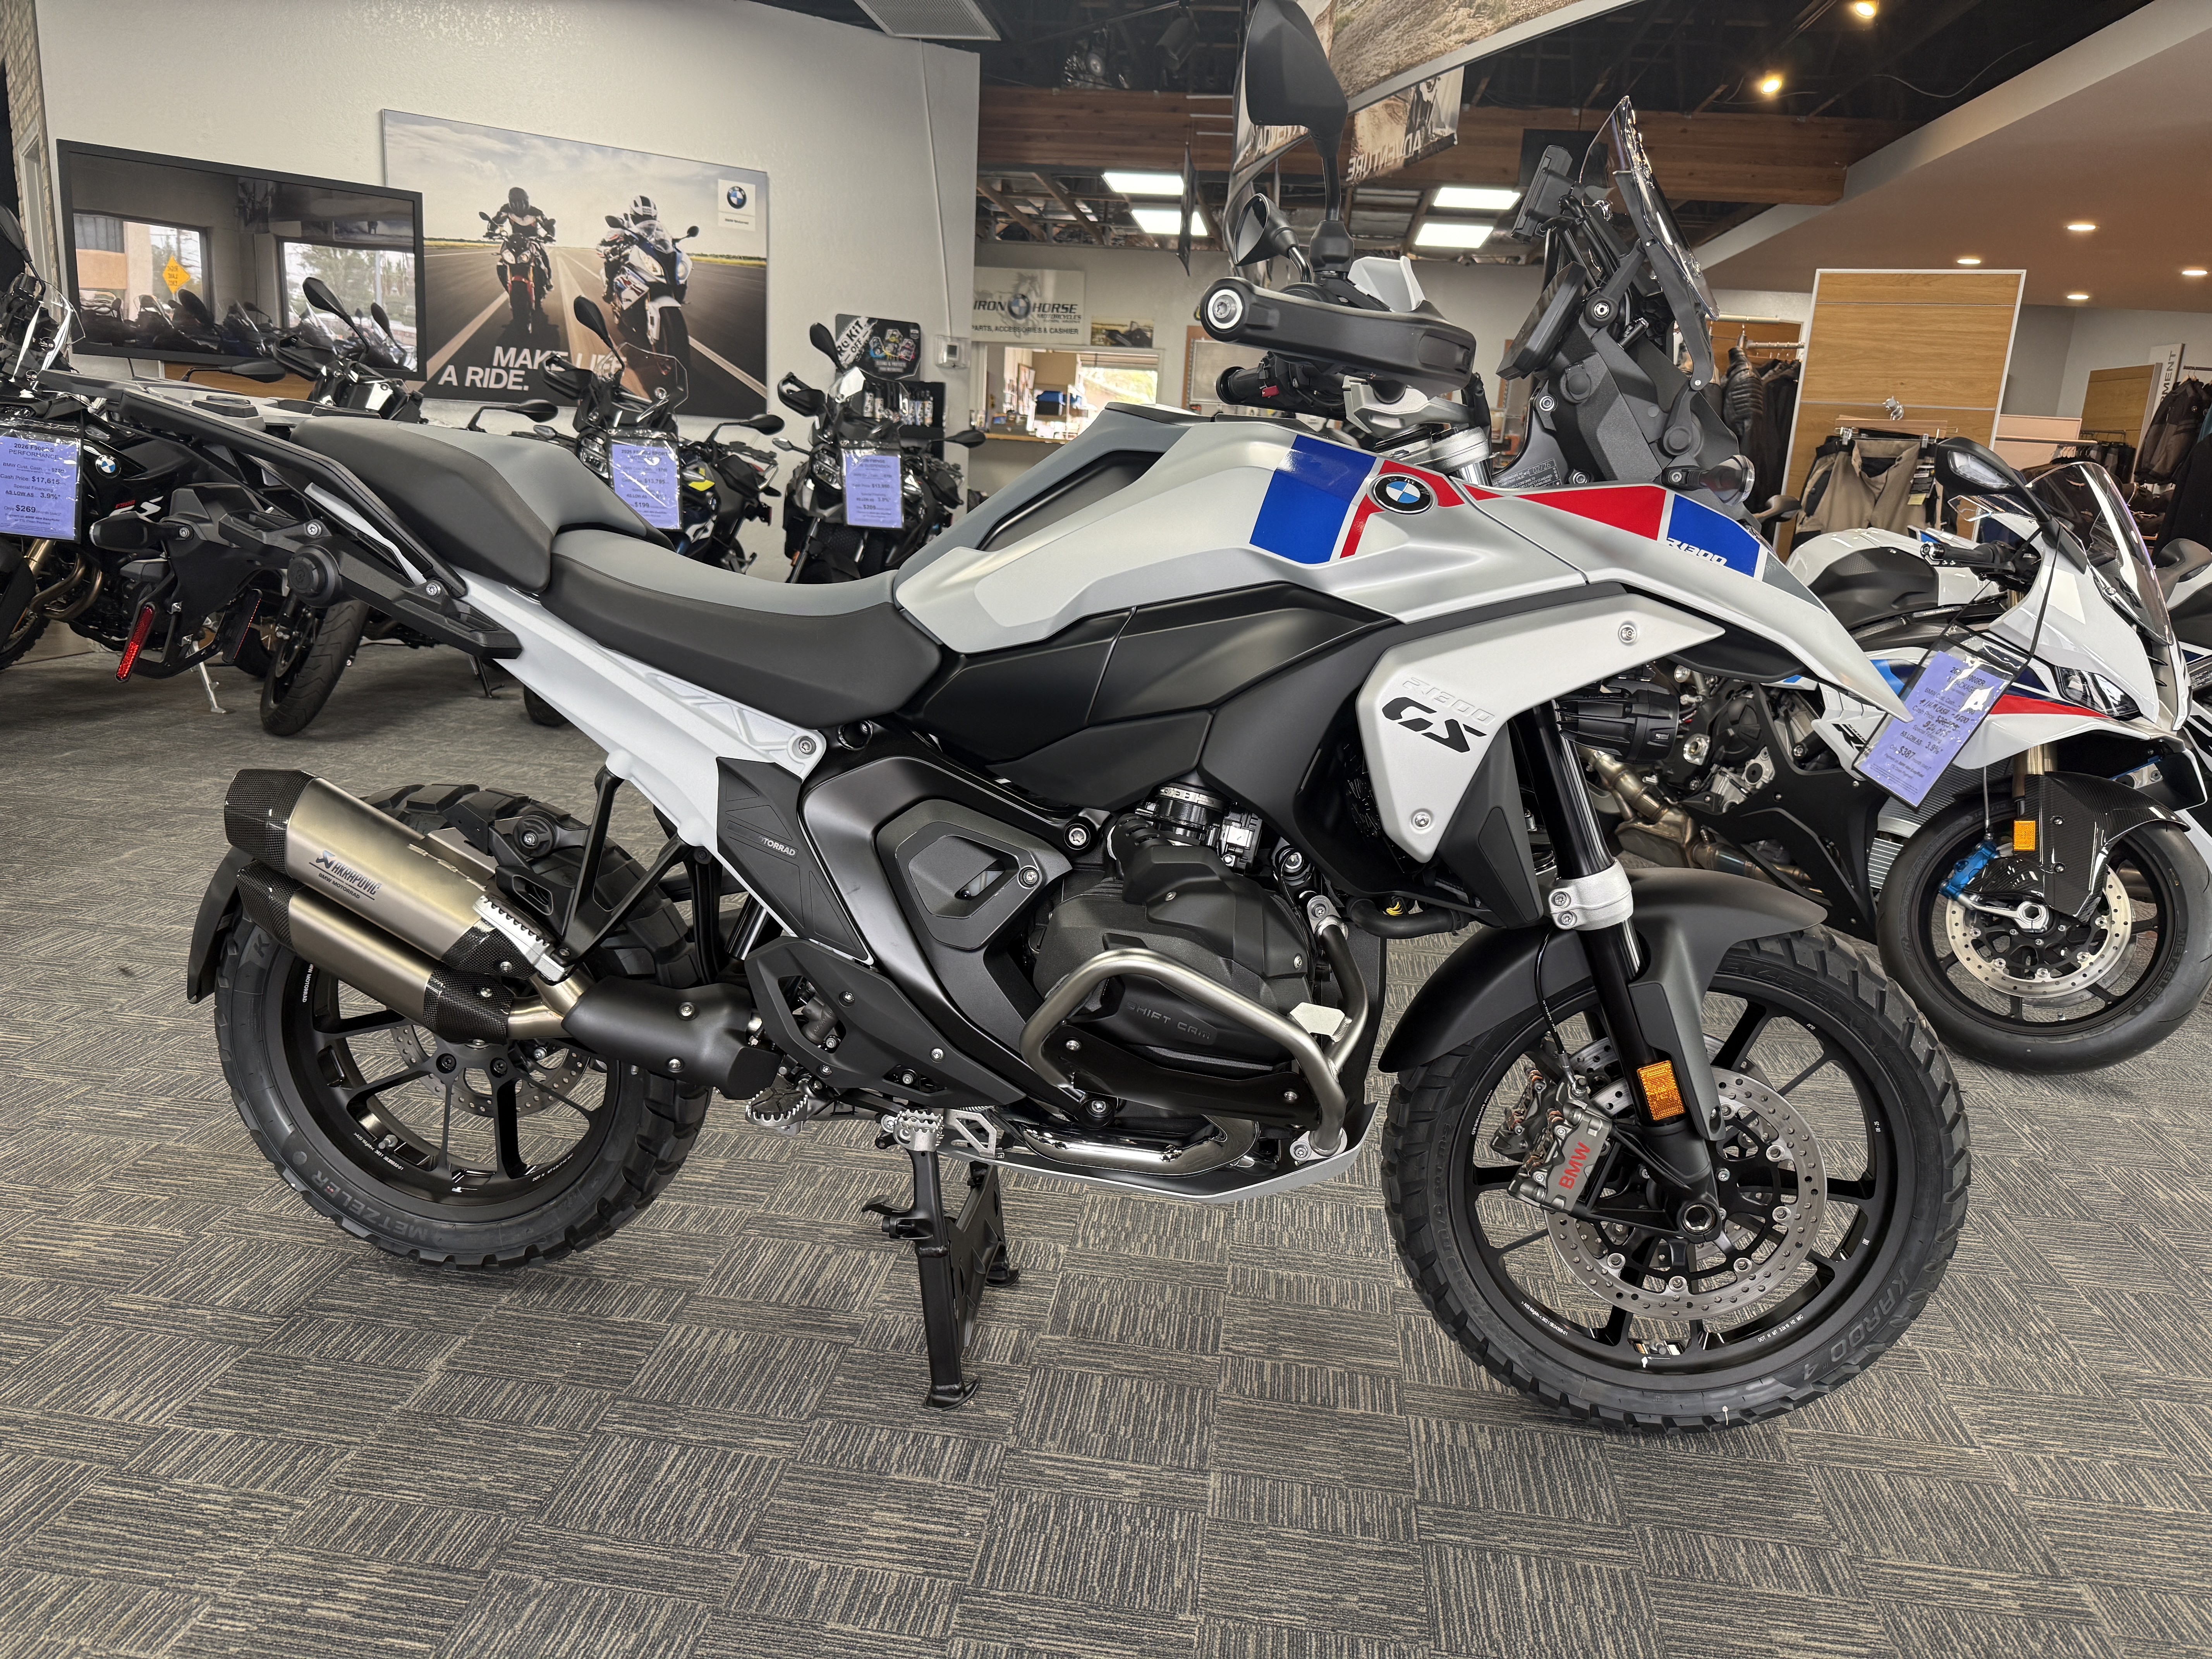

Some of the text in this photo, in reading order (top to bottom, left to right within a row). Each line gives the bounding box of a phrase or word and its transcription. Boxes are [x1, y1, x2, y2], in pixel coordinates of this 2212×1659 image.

[973, 301, 1078, 314] IRON HORSE
[438, 365, 529, 391] A RIDE.
[9, 449, 60, 460] PERFORMANCE
[1533, 462, 1551, 473] 02/26
[32, 476, 60, 485] $17,615
[15, 505, 36, 513] $269
[1667, 537, 1728, 566] R1300
[1966, 675, 1986, 687] 1000RR
[1912, 705, 1924, 715] Cash
[1382, 697, 1488, 753] GS
[1898, 745, 1916, 760] $387
[319, 872, 332, 883] BMW
[332, 880, 361, 899] MOTORRAD
[2146, 931, 2188, 1003] METZELER
[302, 974, 311, 1003] MOTORRAD
[1127, 1001, 1210, 1040] SHIFT CAM
[1558, 1140, 1591, 1190] BMW
[311, 1170, 428, 1241] METZELER
[1830, 1266, 1909, 1362] KAROO
[1803, 1363, 1820, 1381] 4
